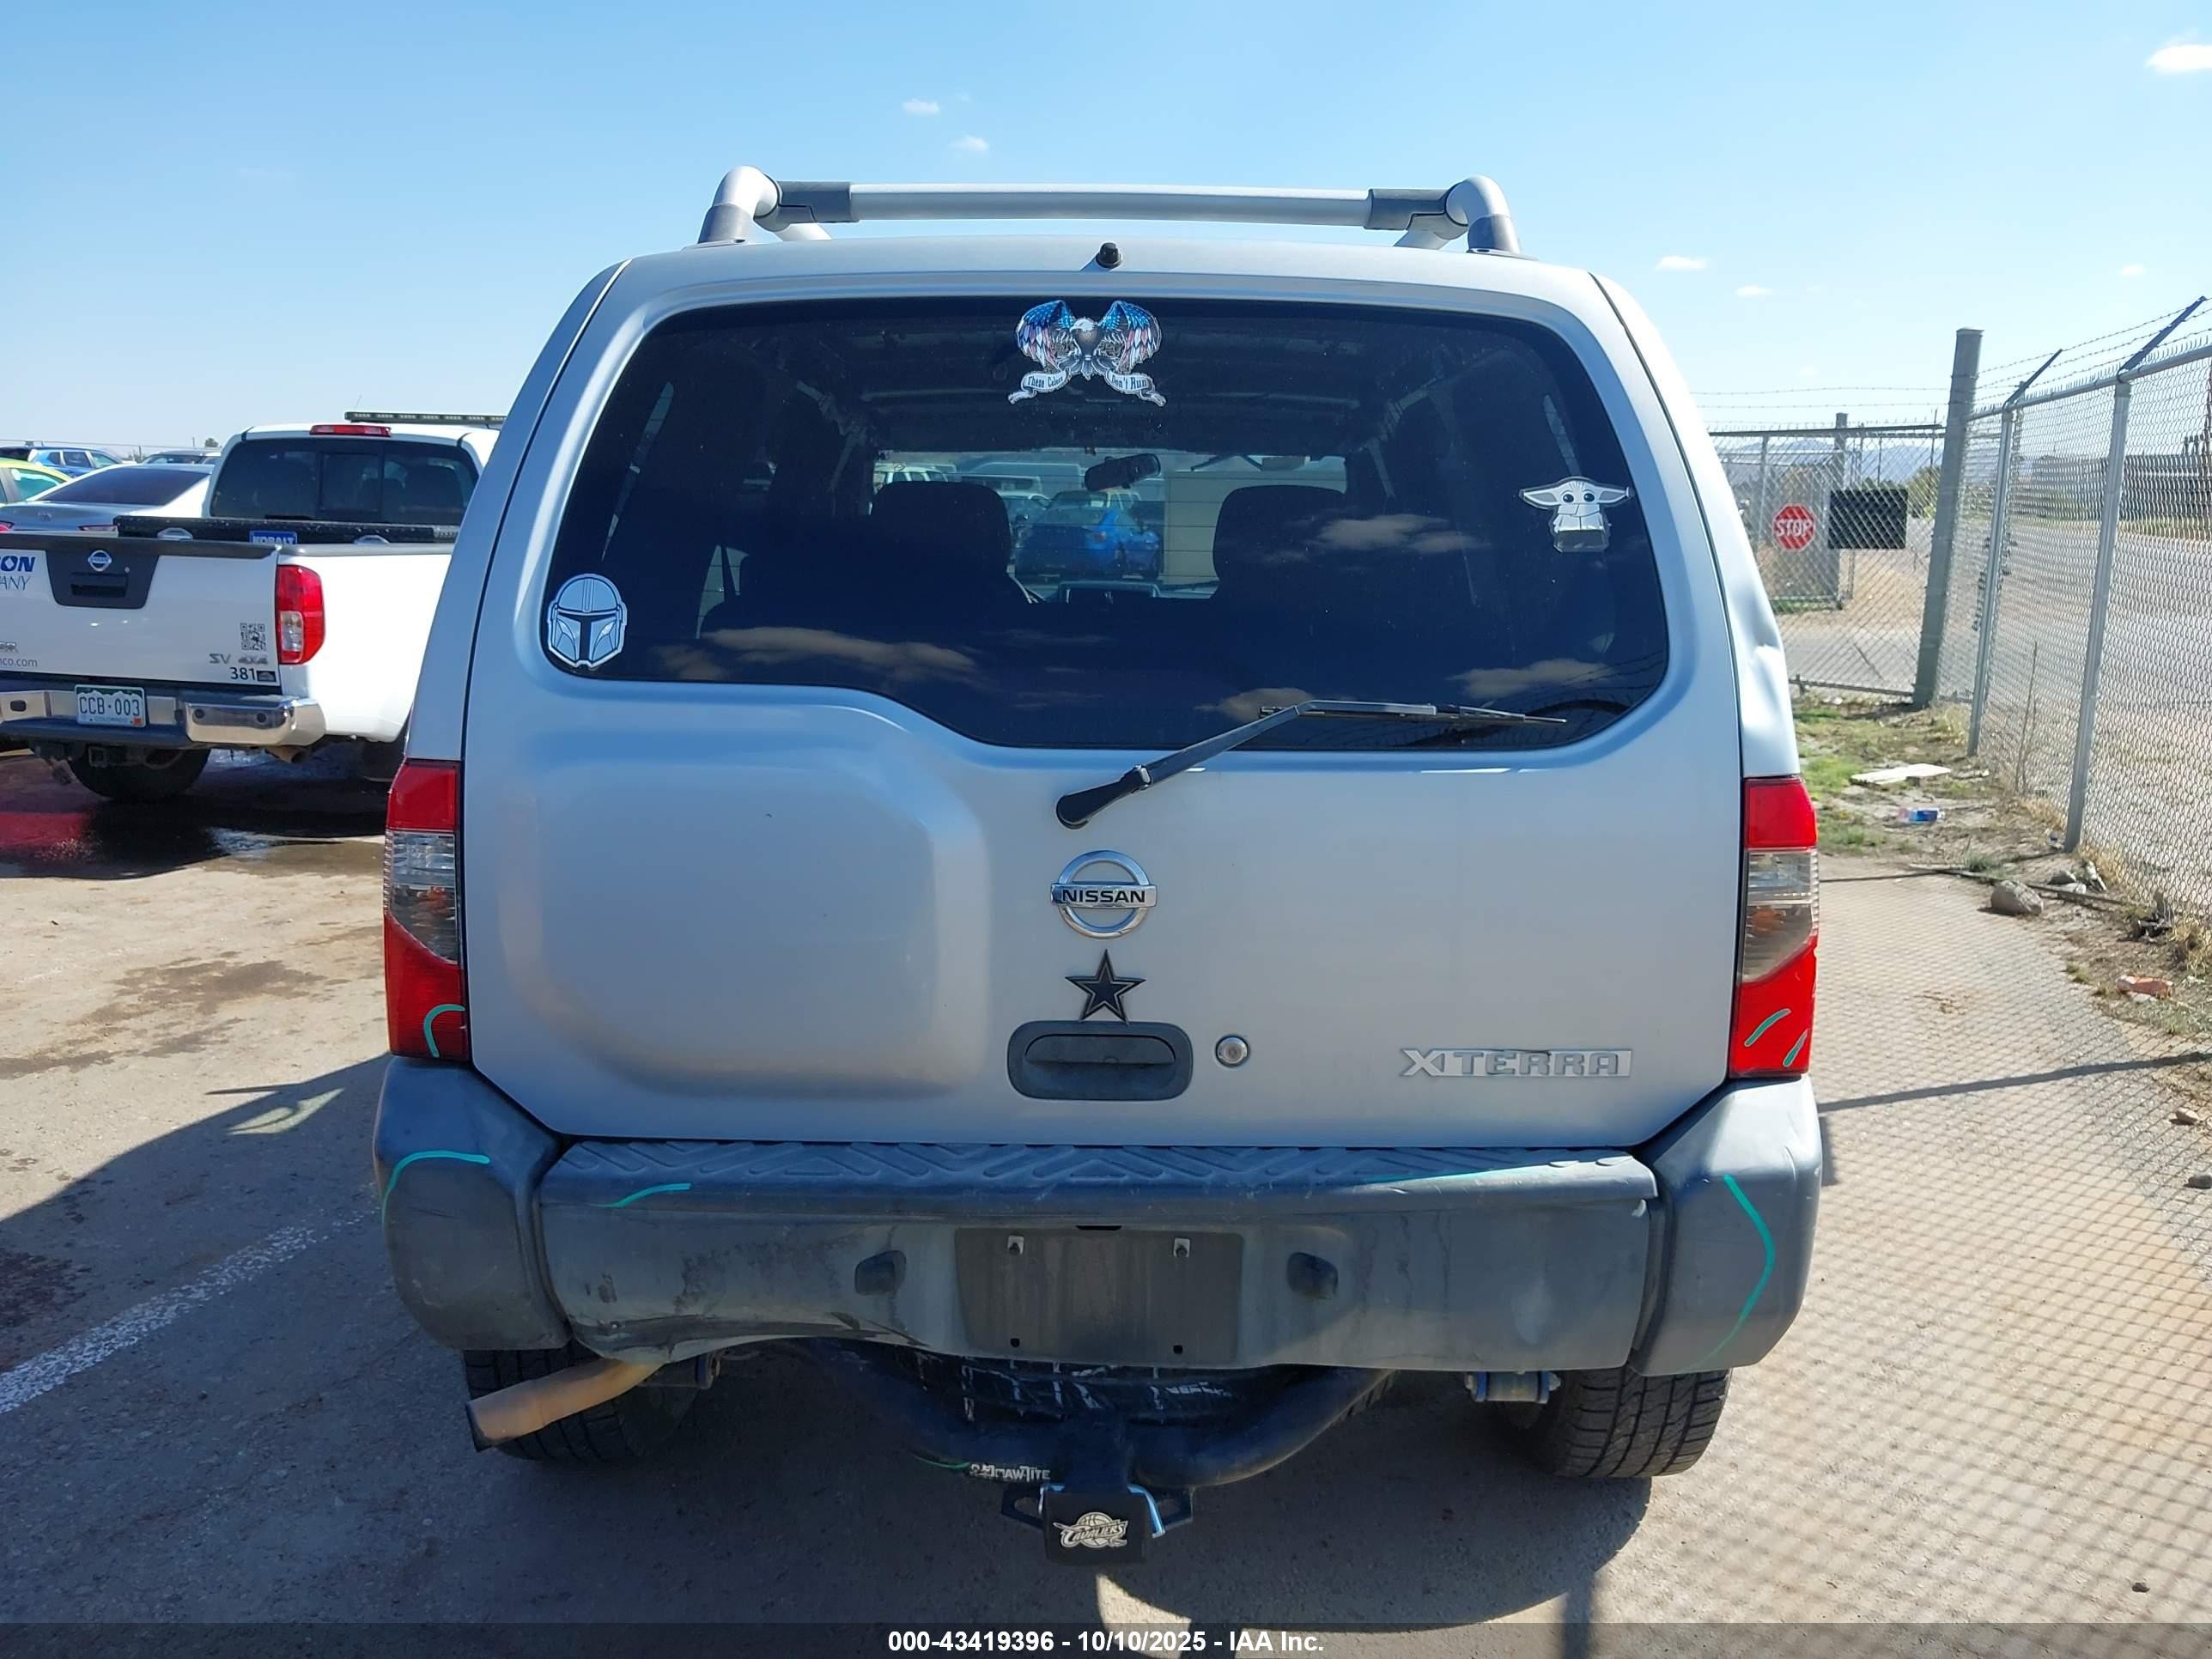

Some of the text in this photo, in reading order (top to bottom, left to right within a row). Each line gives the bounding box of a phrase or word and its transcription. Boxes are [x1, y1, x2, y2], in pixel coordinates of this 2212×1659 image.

[1130, 377, 1147, 389] Run
[1775, 519, 1813, 537] STOP
[0, 556, 35, 572] ON
[0, 575, 30, 591] ANY
[229, 667, 255, 681] 381
[1061, 889, 1146, 903] NISSAN
[1400, 1048, 1632, 1077] XTERRA
